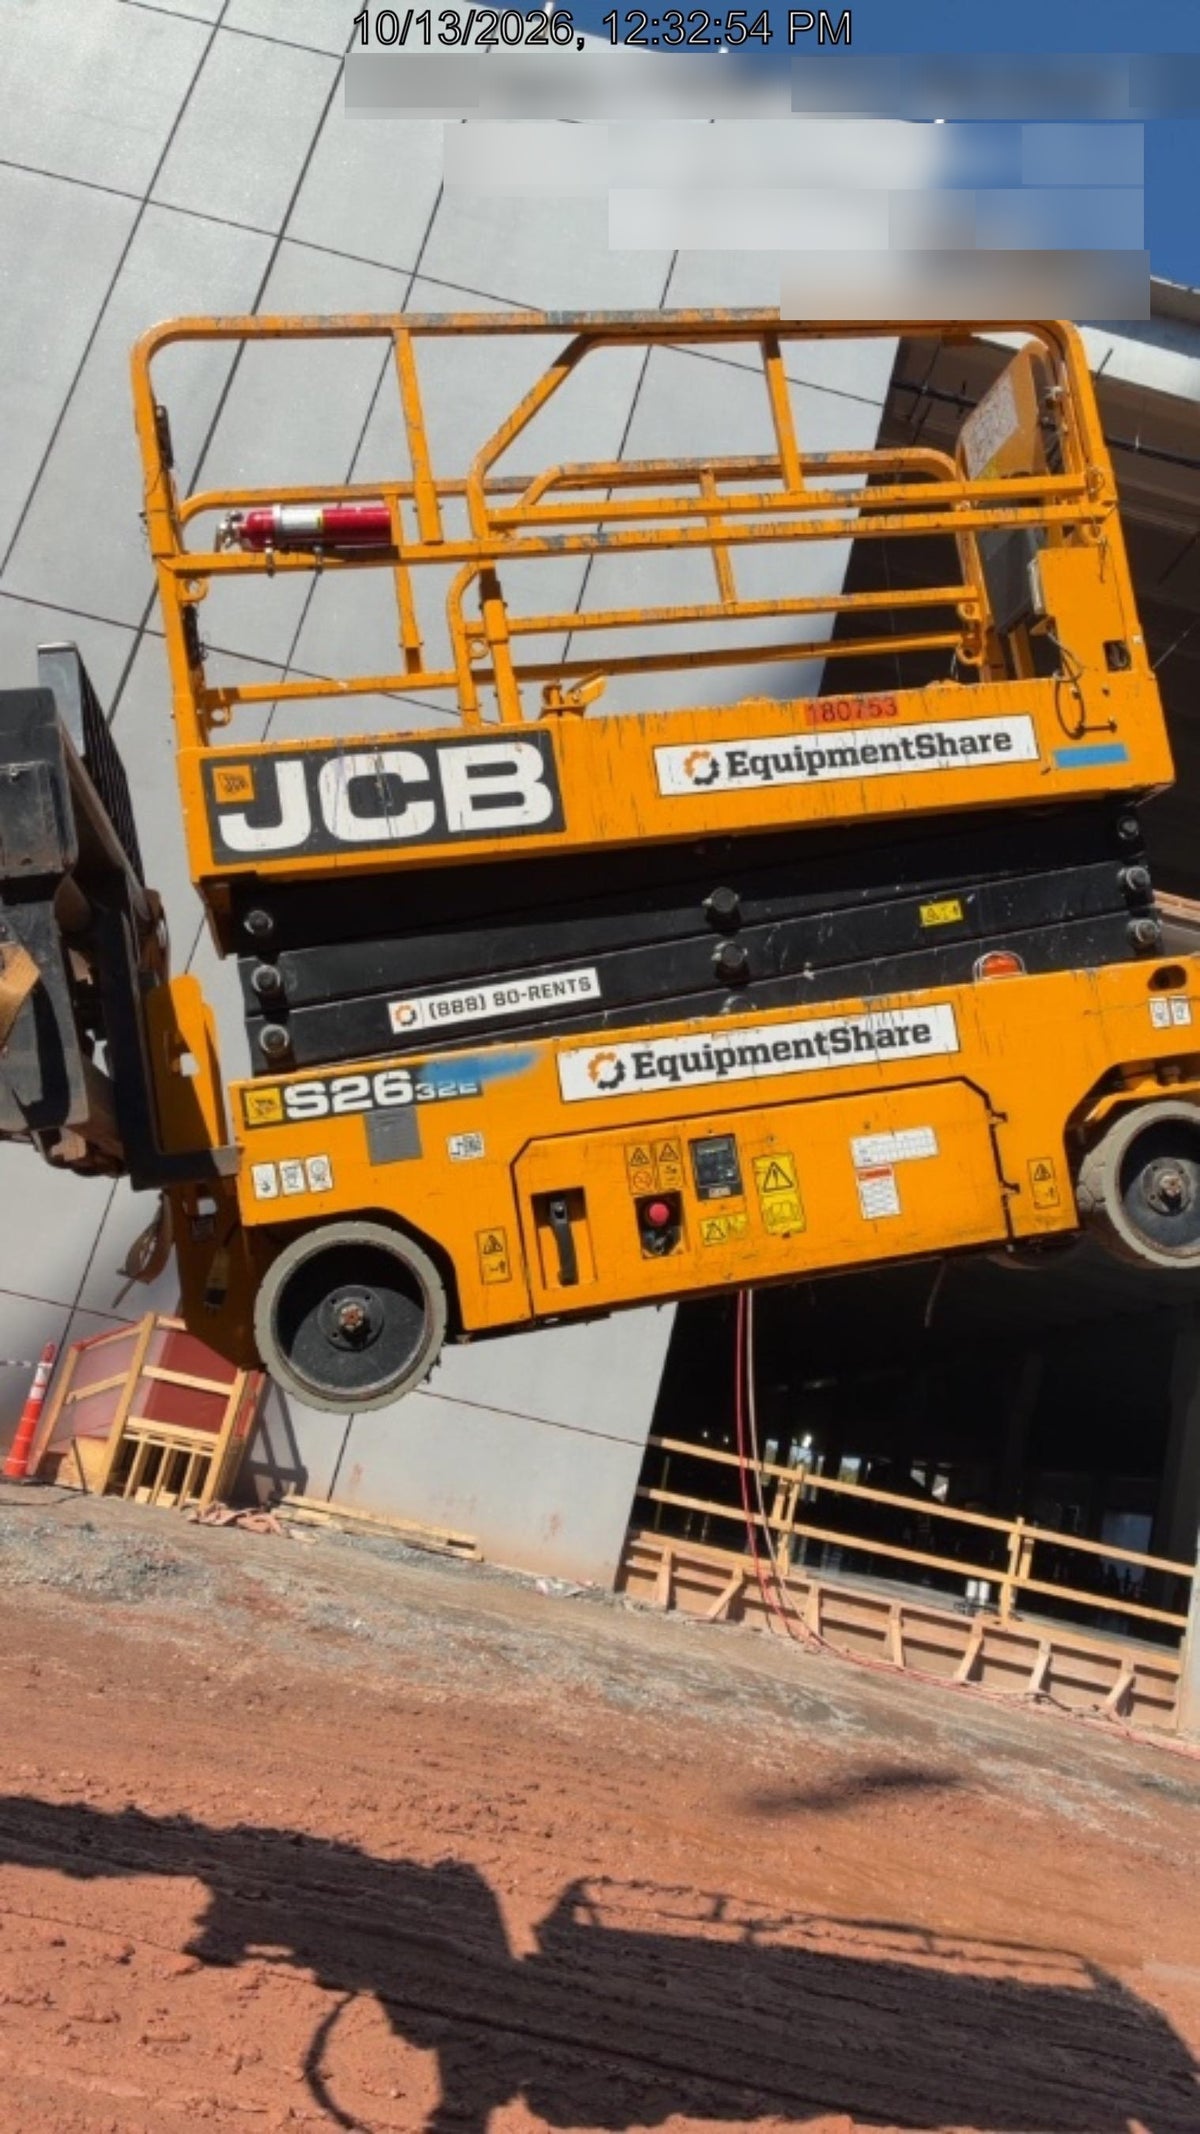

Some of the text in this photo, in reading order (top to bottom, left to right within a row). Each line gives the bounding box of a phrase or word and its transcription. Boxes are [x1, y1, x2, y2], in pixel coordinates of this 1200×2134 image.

[725, 731, 1012, 780] EquipmentShare
[218, 742, 554, 852] JCB
[429, 976, 592, 1020] (888) 80-RENTS
[631, 1022, 932, 1083] EquipmentShare
